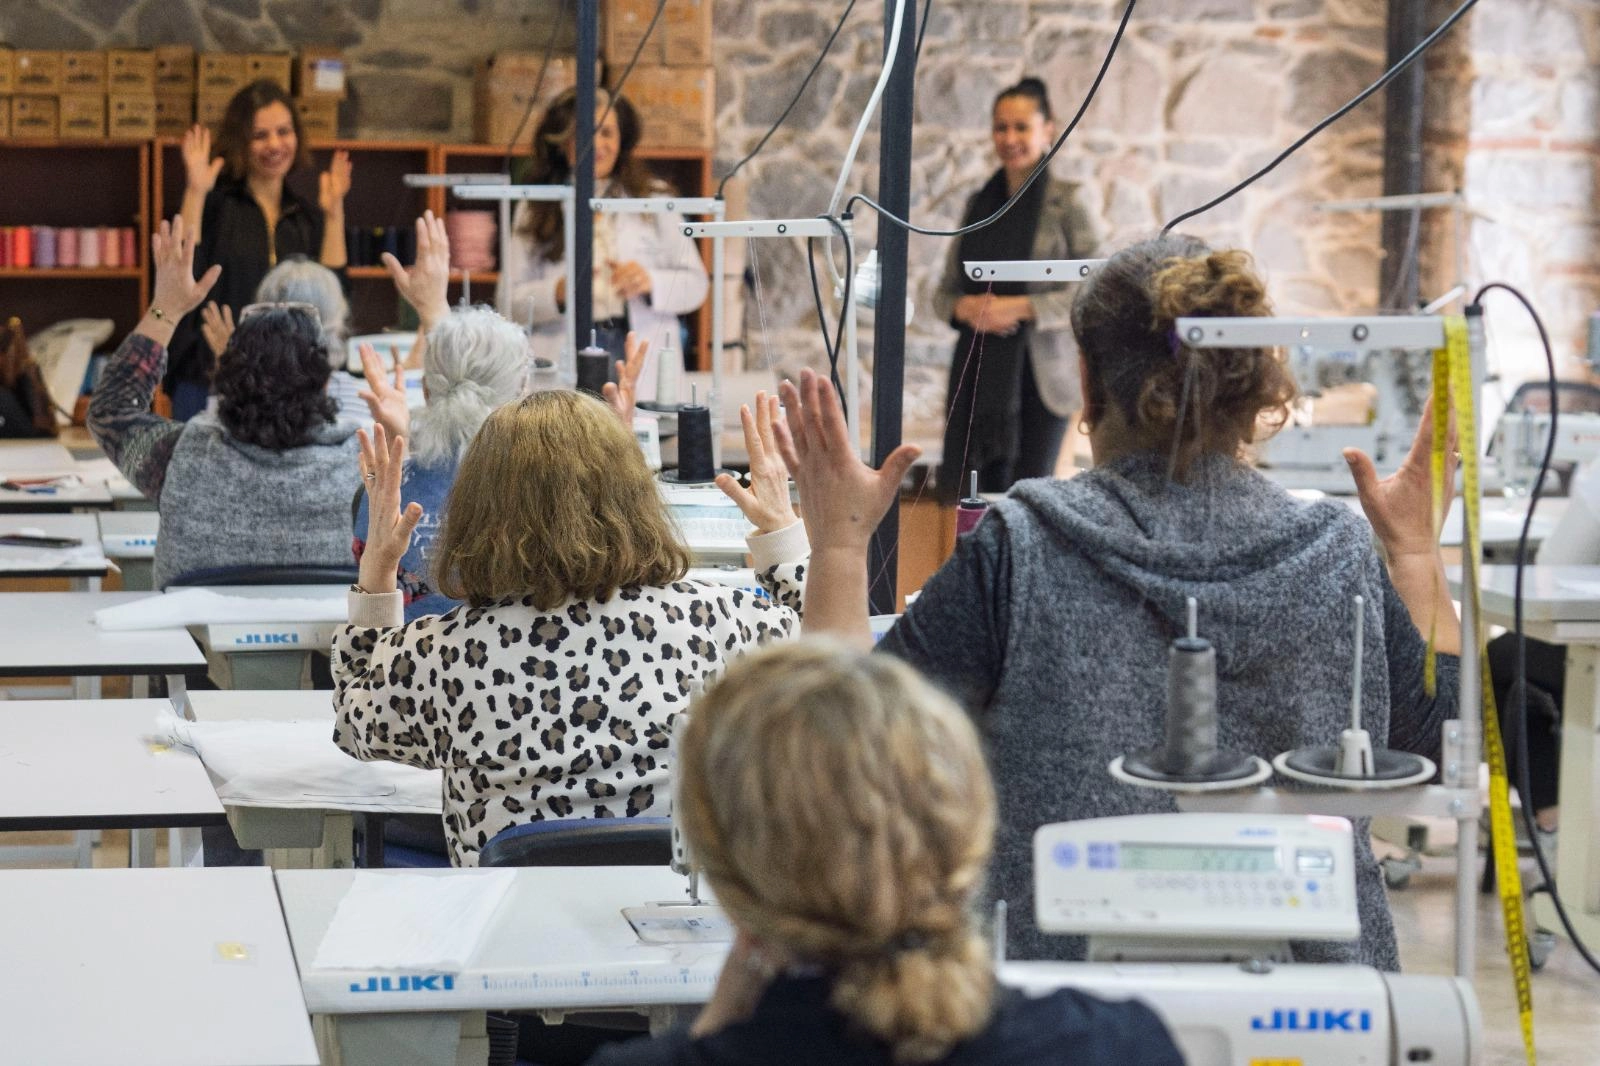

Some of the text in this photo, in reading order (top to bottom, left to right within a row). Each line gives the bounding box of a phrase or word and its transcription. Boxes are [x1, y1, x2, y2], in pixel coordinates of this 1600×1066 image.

[125, 539, 157, 547] JU
[235, 633, 299, 643] JUKI
[350, 975, 454, 992] JUKI
[1252, 1010, 1370, 1031] JUKI
